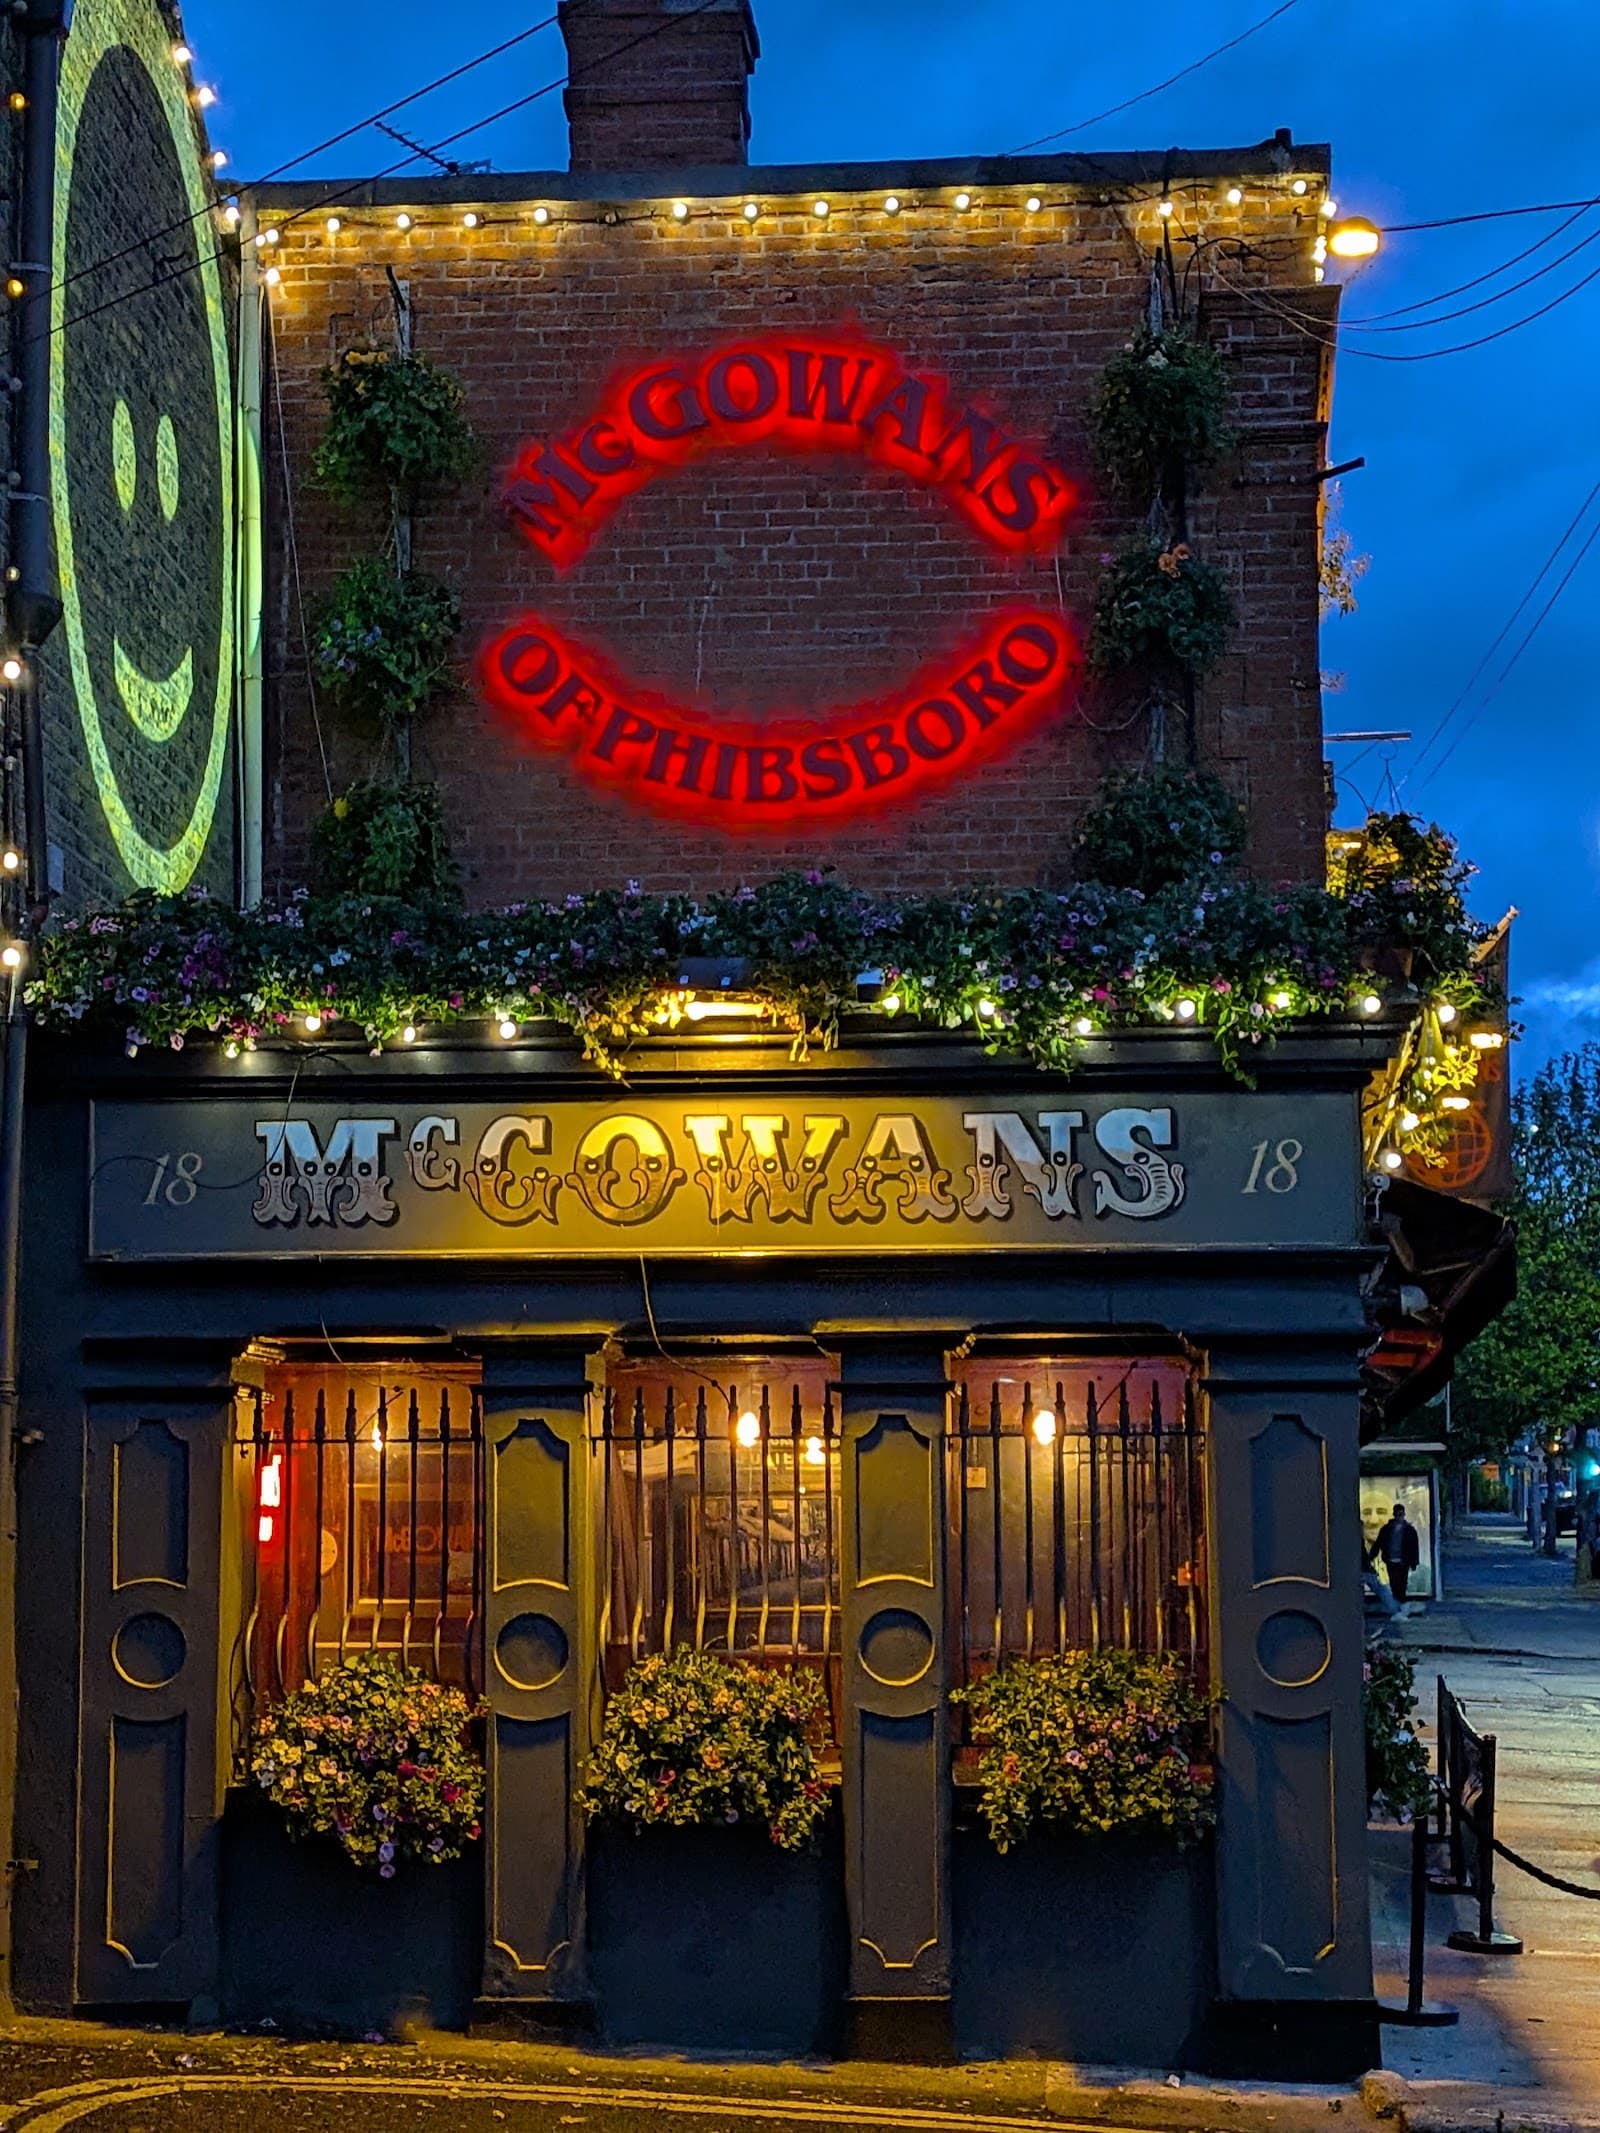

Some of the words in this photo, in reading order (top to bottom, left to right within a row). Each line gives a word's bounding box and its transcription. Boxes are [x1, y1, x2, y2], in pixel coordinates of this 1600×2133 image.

[500, 633, 604, 727] OF
[591, 623, 1058, 801] PHIBSBORO
[143, 1152, 203, 1206] 18
[1240, 1138, 1303, 1194] 18
